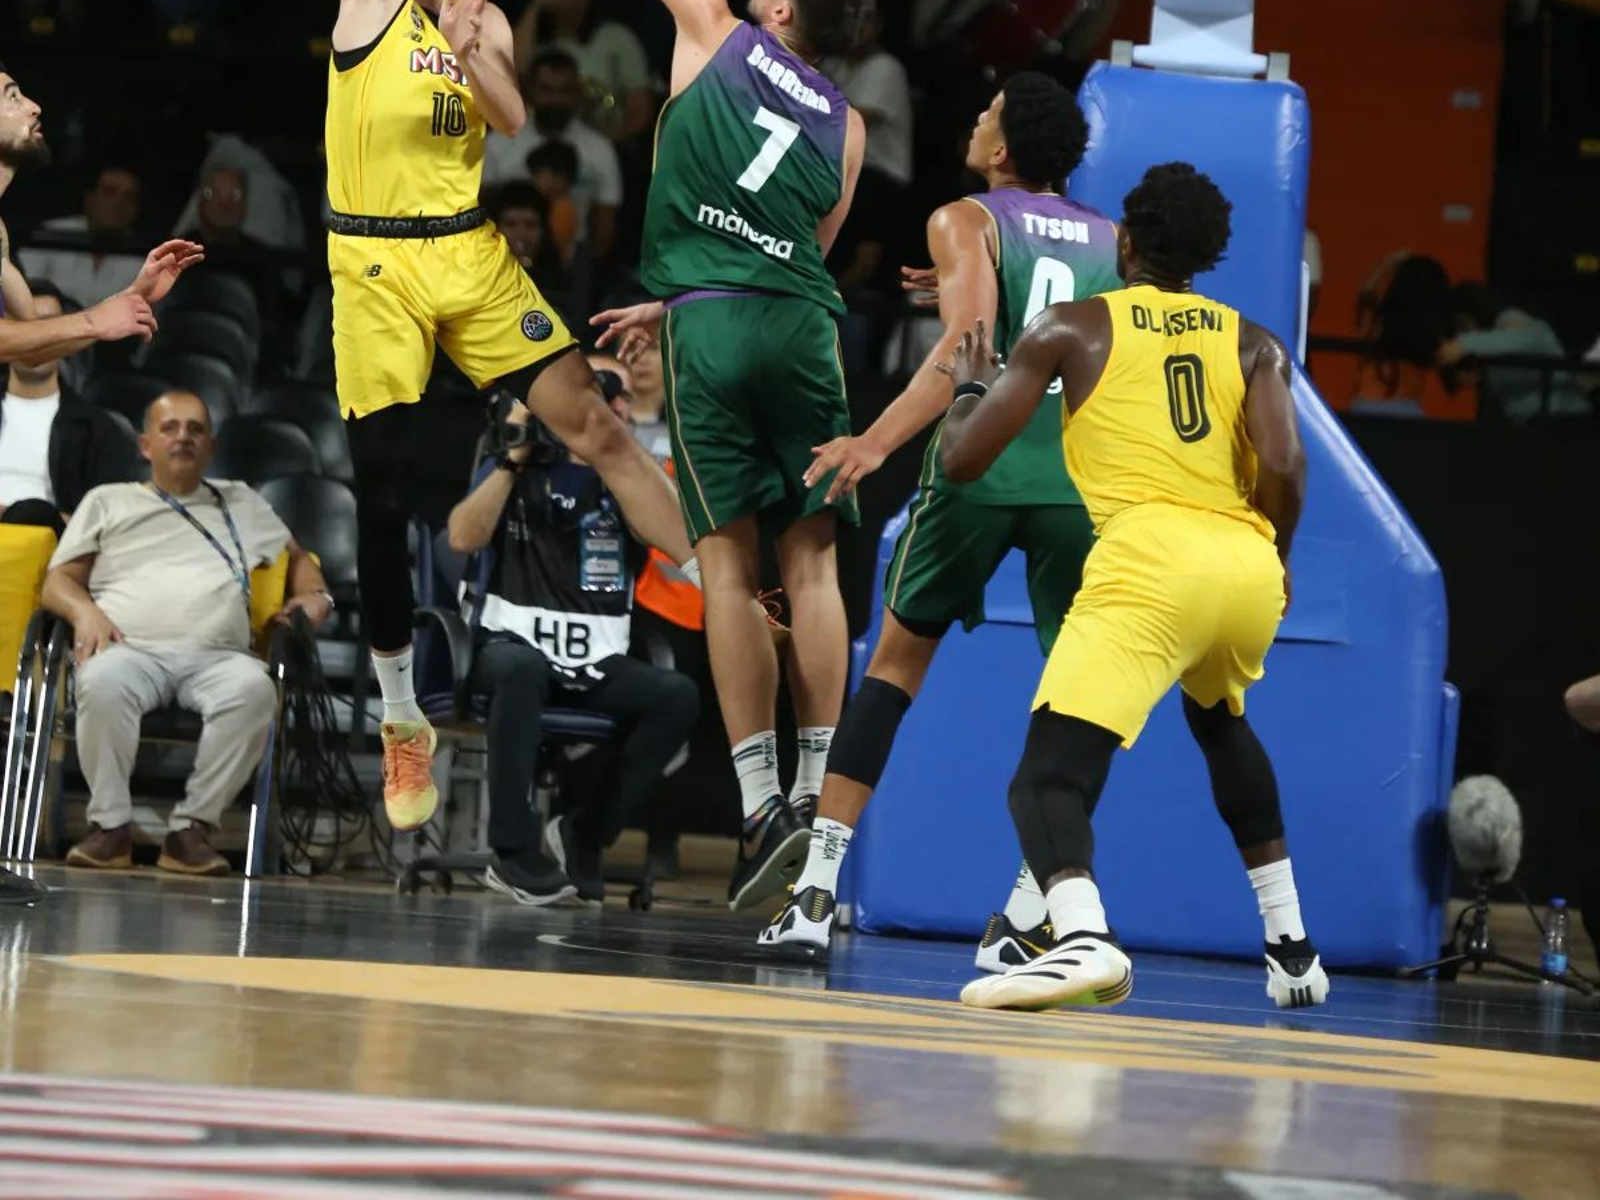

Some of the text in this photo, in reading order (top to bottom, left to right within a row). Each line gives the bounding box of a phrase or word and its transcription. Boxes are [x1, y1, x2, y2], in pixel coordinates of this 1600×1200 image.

[432, 92, 467, 137] 10
[736, 105, 801, 193] 7
[1022, 212, 1090, 244] TYSON
[1131, 304, 1224, 337] OLASENI
[1164, 352, 1212, 444] 0
[533, 616, 591, 659] HB
